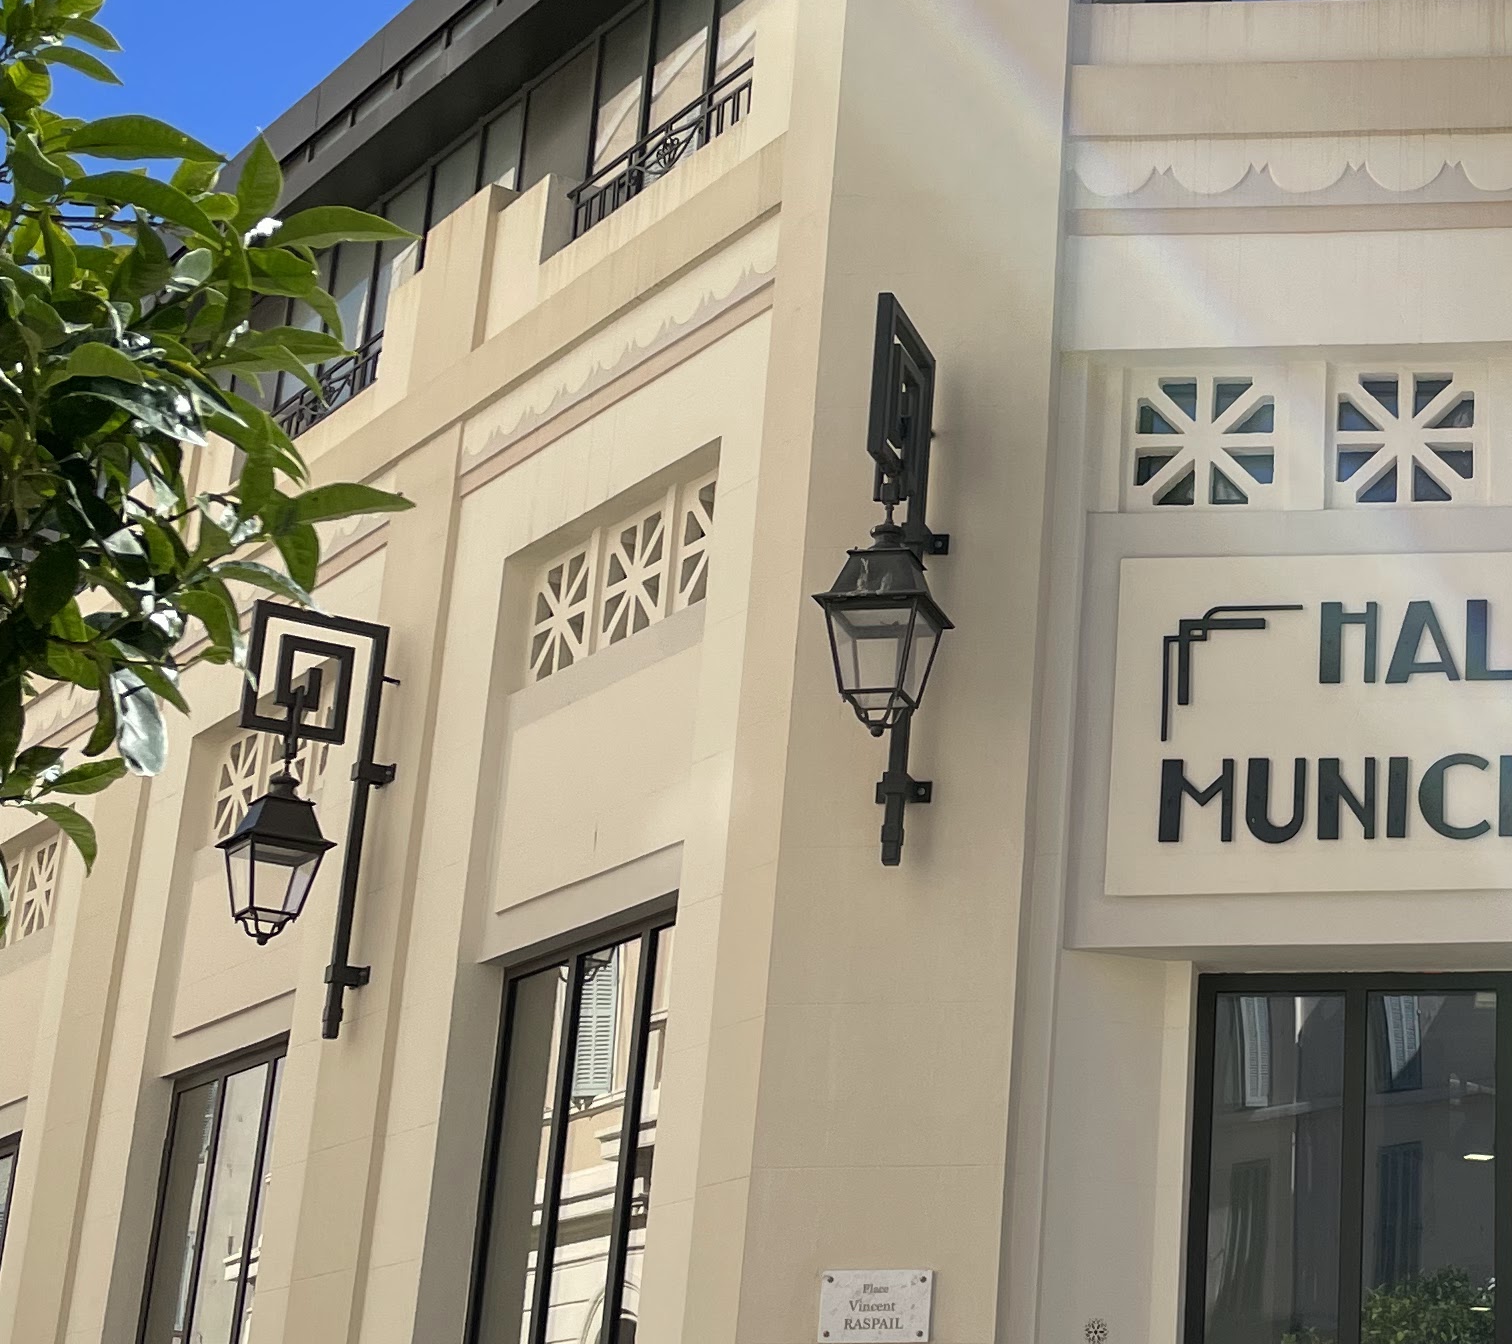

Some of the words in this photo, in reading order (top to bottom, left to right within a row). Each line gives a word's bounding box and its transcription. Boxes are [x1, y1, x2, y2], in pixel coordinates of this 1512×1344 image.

[862, 1283, 889, 1294] Place
[849, 1299, 896, 1312] Vincent
[843, 1317, 904, 1330] RASPAIL
